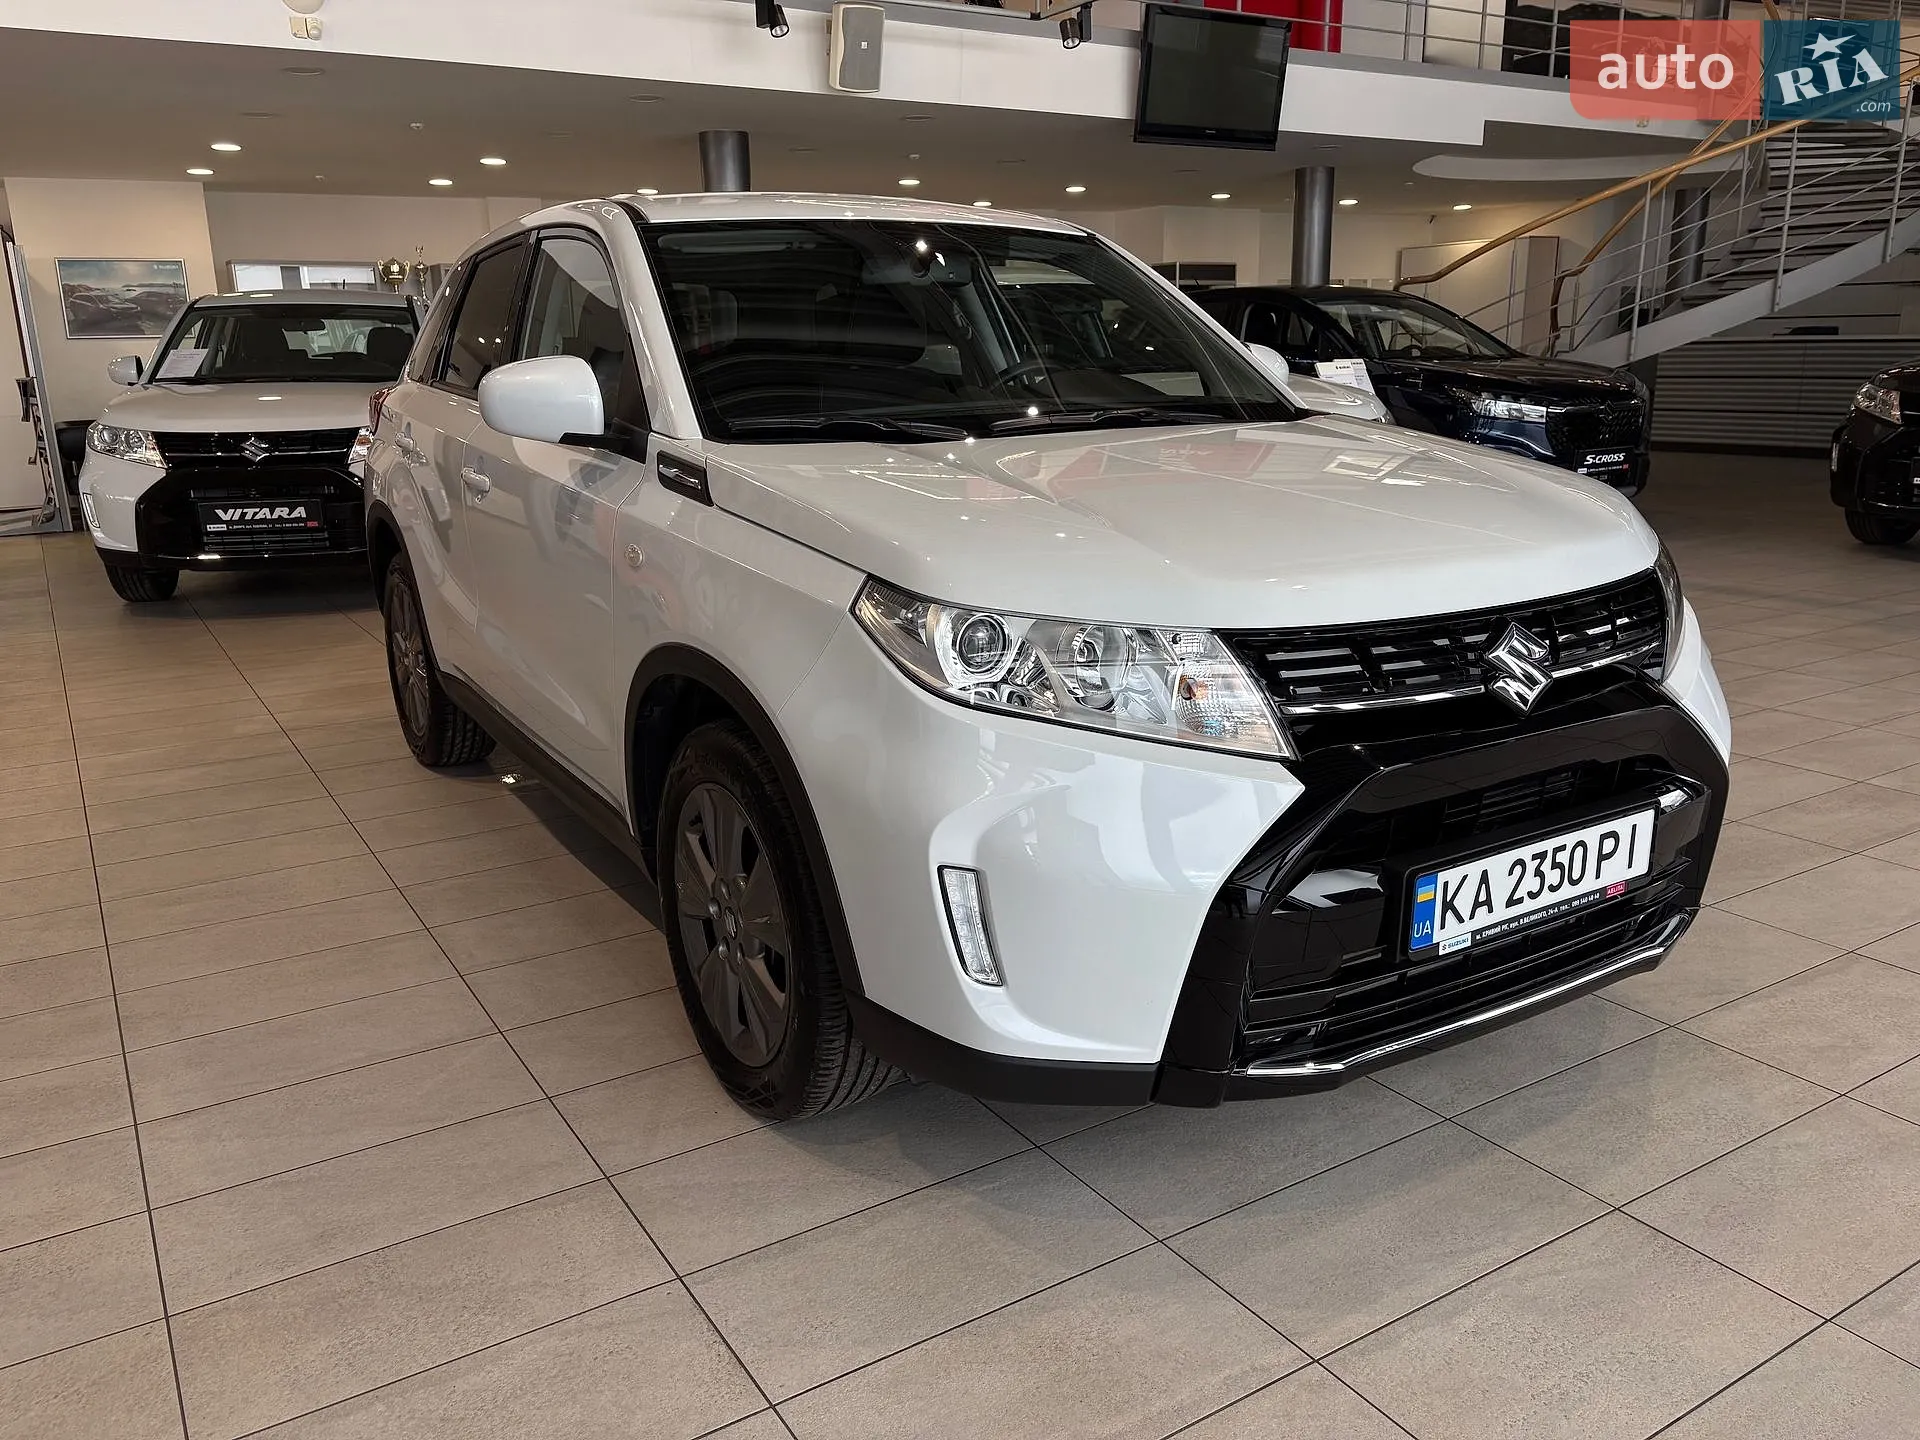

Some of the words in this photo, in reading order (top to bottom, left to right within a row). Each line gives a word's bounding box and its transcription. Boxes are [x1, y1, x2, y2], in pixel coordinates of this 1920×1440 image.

[214, 506, 307, 521] VITARA
[1440, 869, 1494, 930] KA
[1505, 839, 1588, 909] 2350
[1414, 920, 1431, 938] UA
[1447, 937, 1469, 949] SUZUKI
